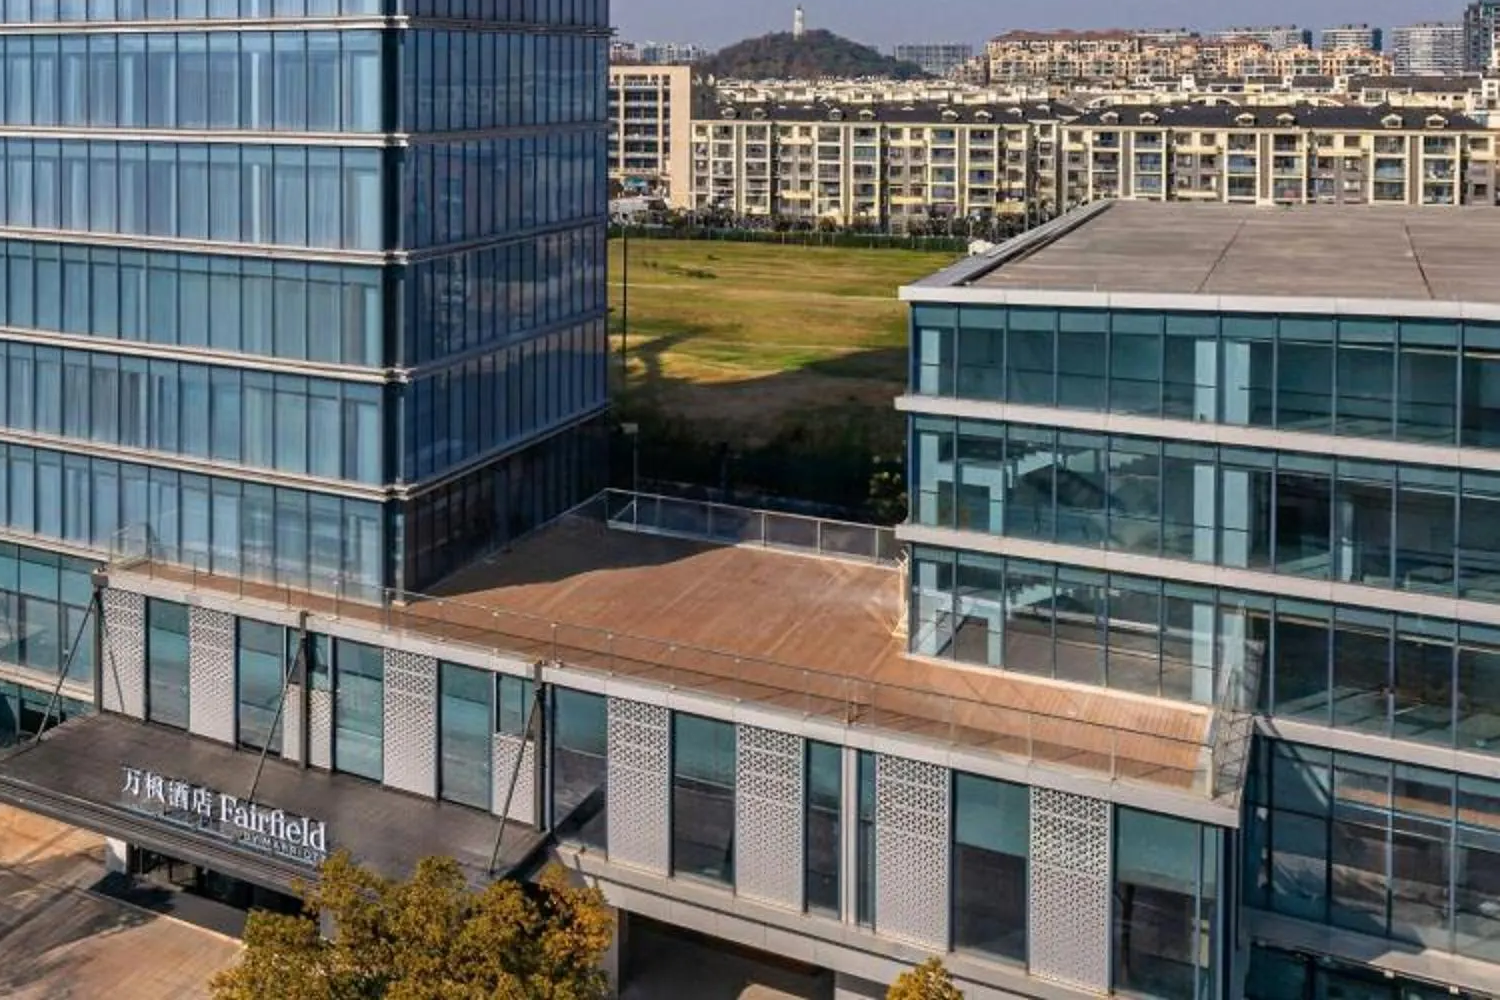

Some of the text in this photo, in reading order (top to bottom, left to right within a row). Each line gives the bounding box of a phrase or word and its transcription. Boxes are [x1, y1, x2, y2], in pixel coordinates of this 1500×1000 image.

[122, 767, 212, 817] 万枫酒店
[221, 793, 325, 851] Fairfield
